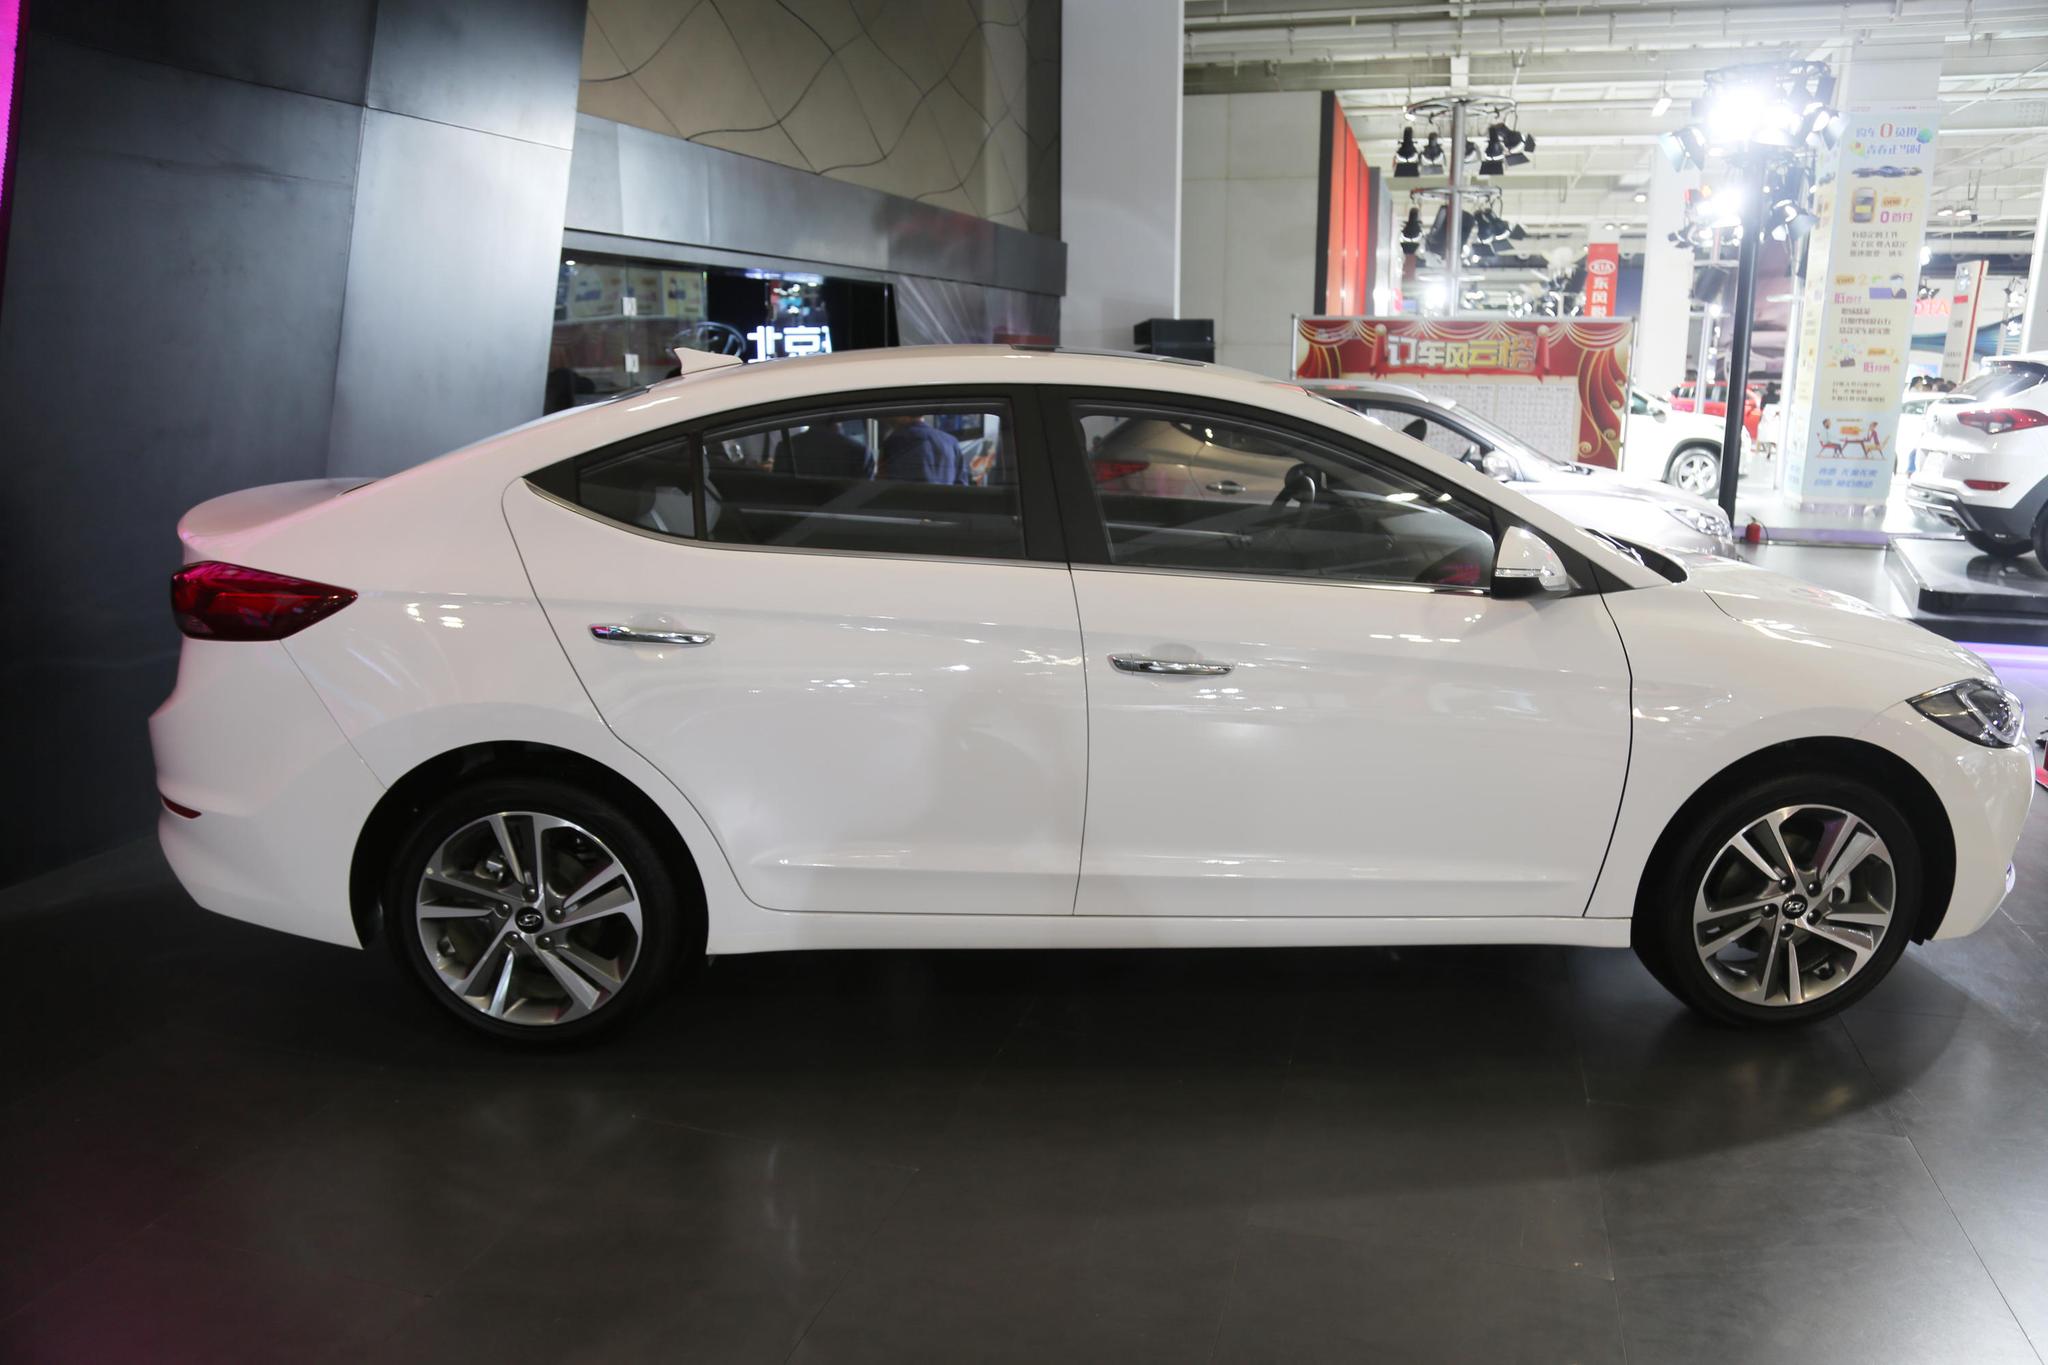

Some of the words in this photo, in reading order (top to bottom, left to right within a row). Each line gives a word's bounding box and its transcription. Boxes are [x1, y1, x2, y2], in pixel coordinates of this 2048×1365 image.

[746, 325, 833, 364] 北京
[1387, 334, 1538, 371] 订车风云榜
